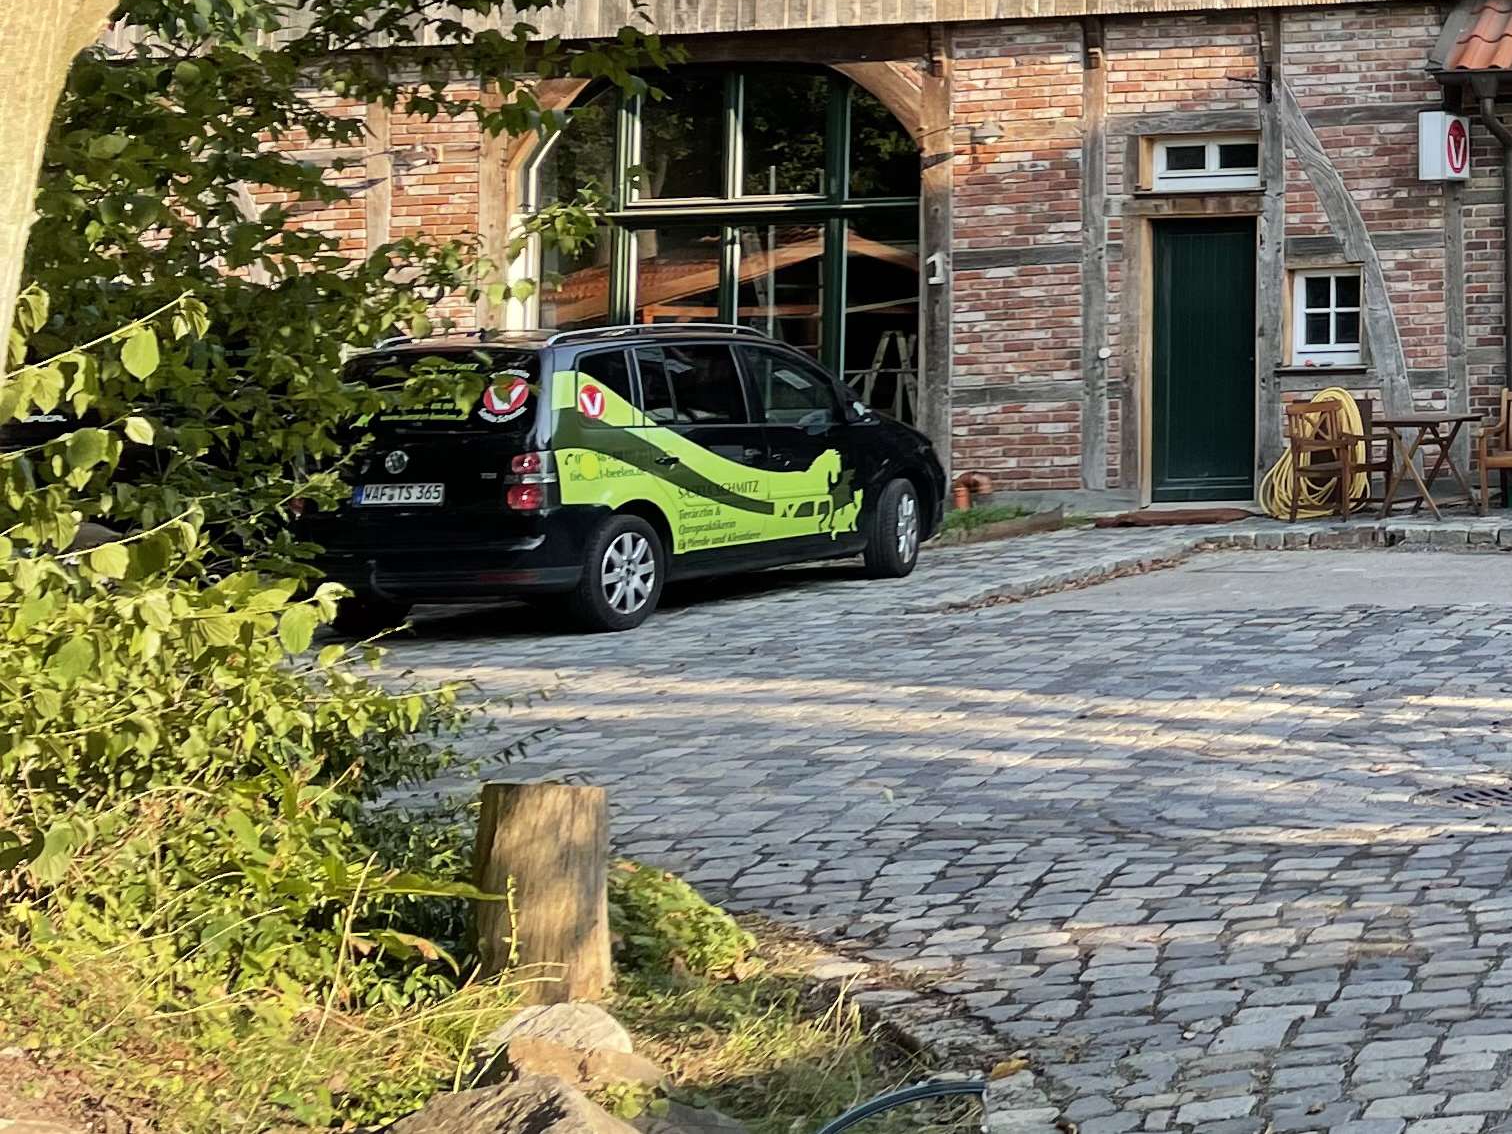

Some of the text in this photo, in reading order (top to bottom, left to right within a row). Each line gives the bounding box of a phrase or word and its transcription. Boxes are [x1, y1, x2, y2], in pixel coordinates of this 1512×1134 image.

[1449, 135, 1465, 169] V
[926, 251, 945, 285] 1
[580, 392, 602, 415] V
[397, 485, 413, 501] TS
[416, 485, 441, 500] 365
